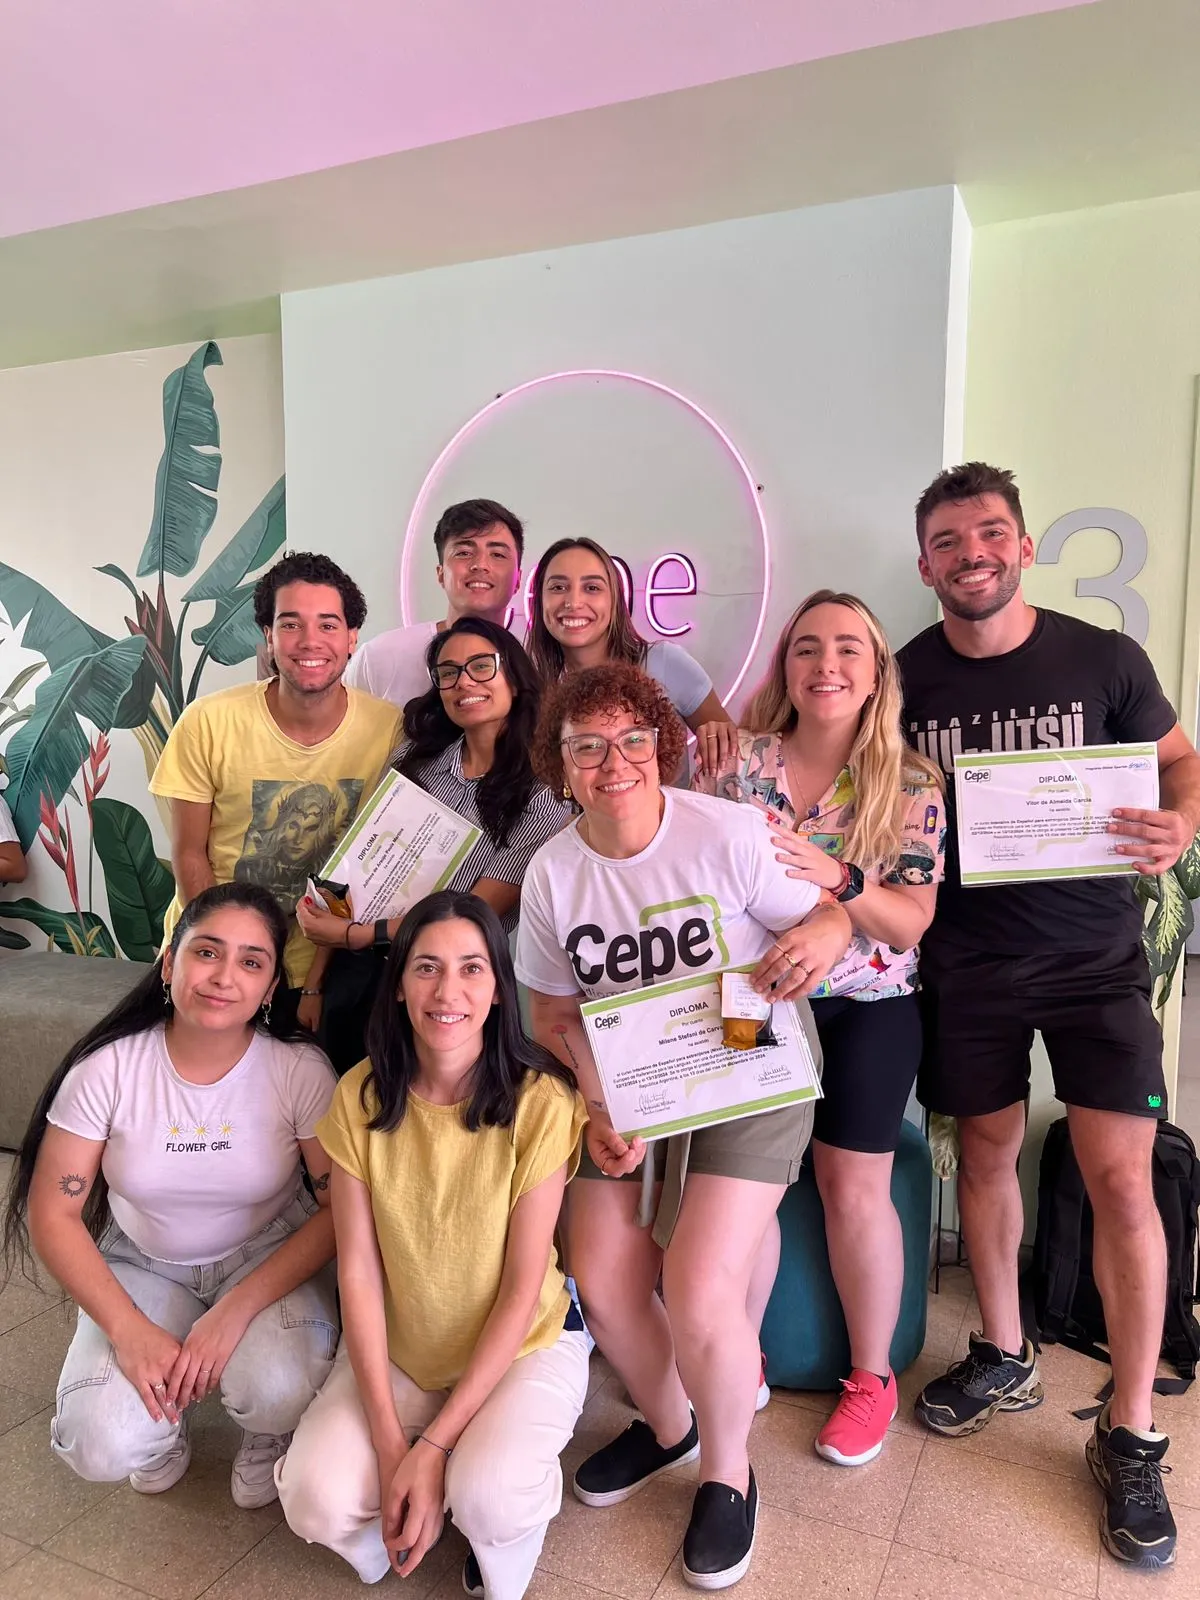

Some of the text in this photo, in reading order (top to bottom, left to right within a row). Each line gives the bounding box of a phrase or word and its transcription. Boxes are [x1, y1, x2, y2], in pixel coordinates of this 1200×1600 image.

[1036, 507, 1149, 648] 3
[910, 701, 1083, 732] BRAZILIAN
[964, 770, 990, 783] Cepe
[1038, 774, 1079, 784] DIPLOMA
[357, 833, 379, 861] DIPLOMA
[565, 917, 714, 988] Cepe
[669, 1001, 709, 1018] DIPLOMA
[594, 1014, 620, 1029] Cepe
[166, 1141, 232, 1152] FLOWER GIRL
